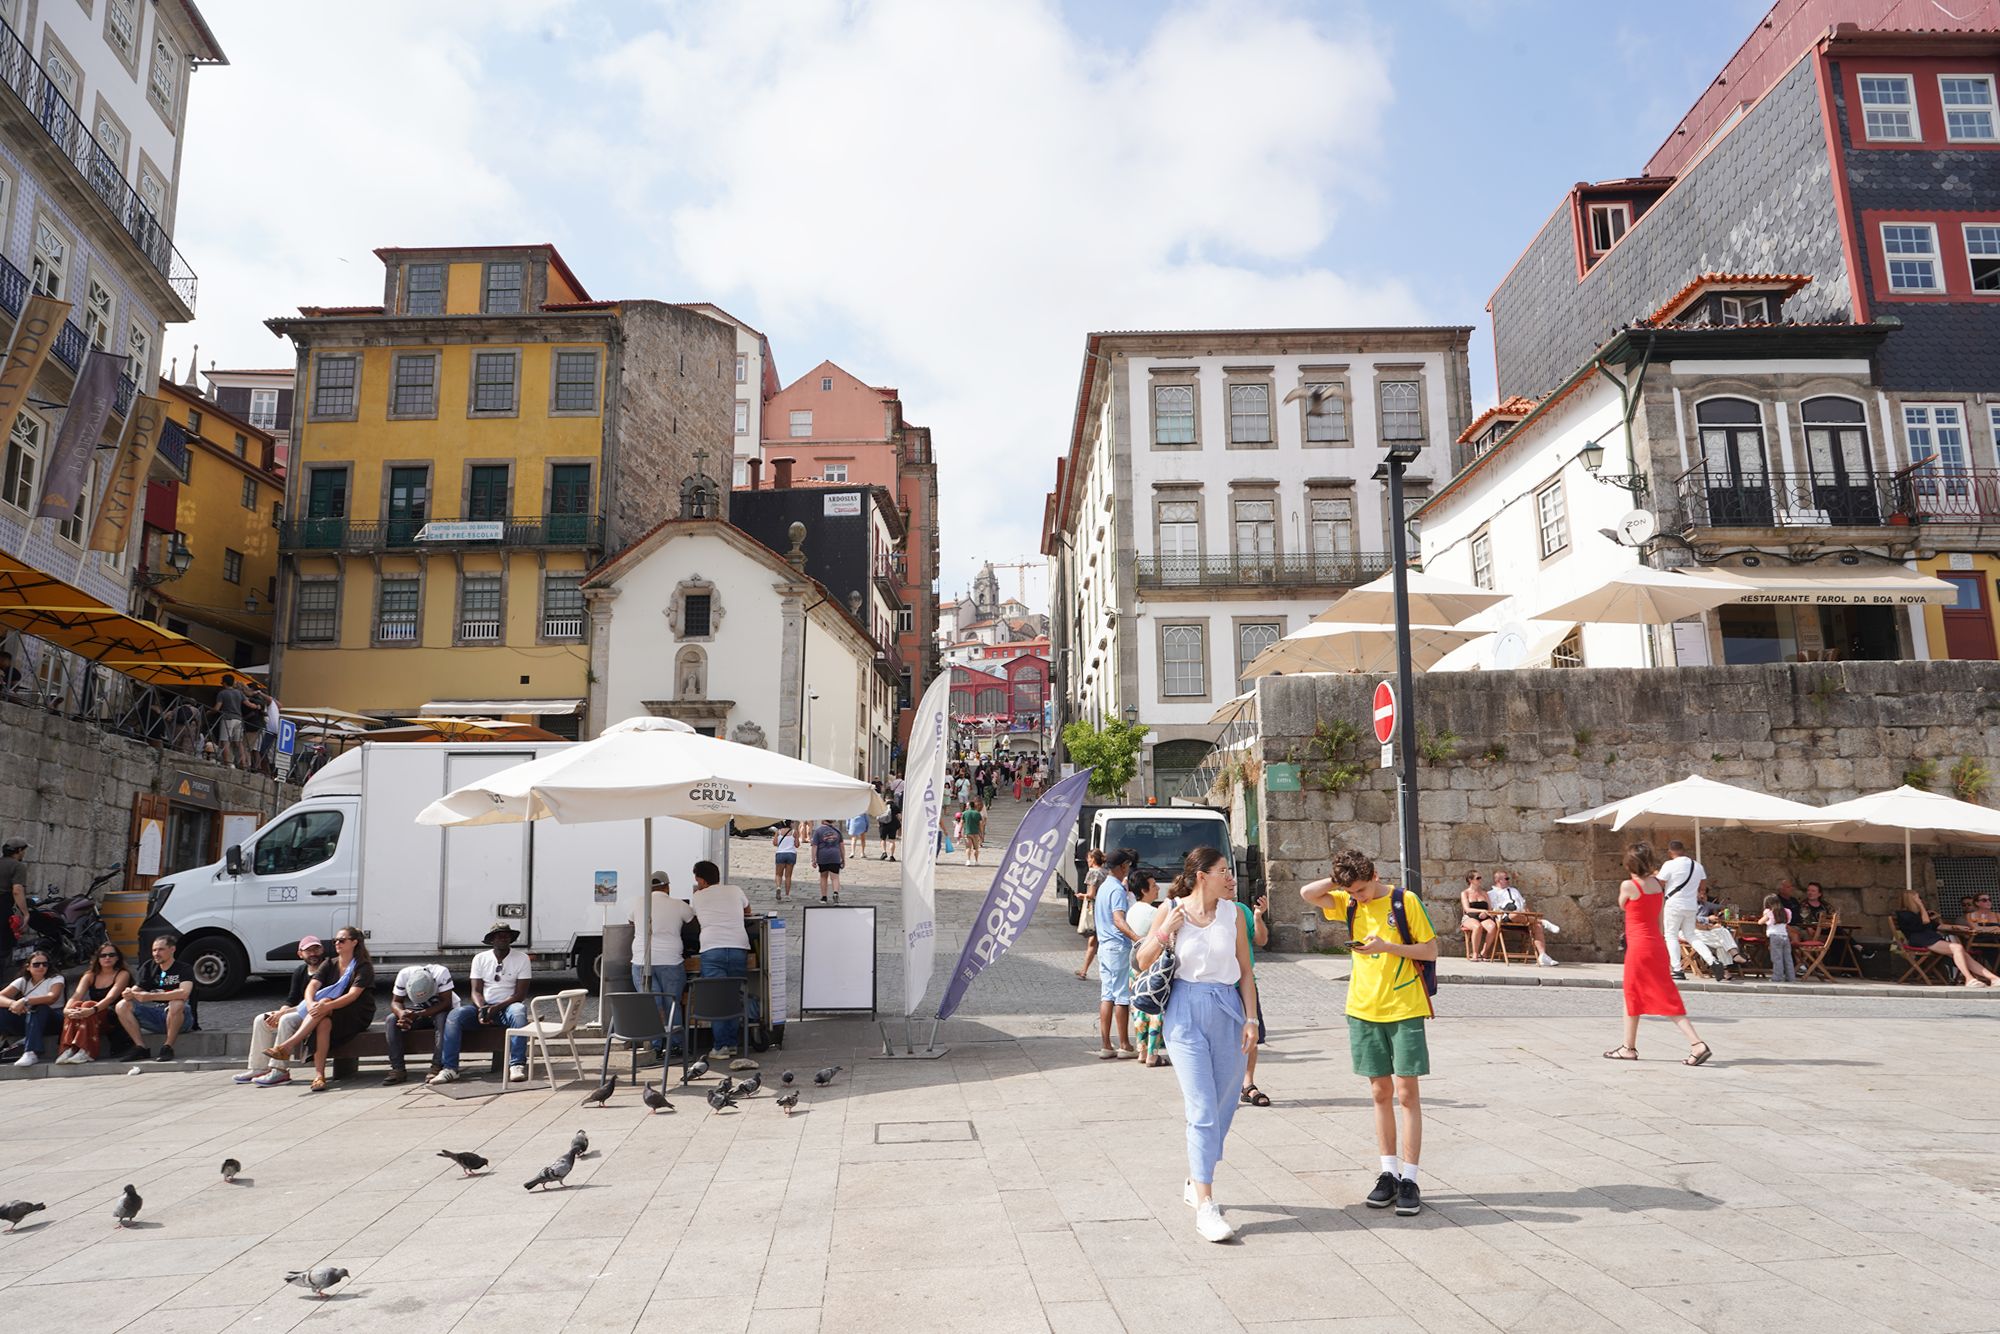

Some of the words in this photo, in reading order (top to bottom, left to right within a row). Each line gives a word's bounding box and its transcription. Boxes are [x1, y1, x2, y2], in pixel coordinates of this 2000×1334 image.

[1626, 518, 1647, 528] ZON
[1740, 595, 1811, 603] RESTAURANTE
[1817, 595, 1847, 603] FAROL
[1853, 595, 1866, 603] DA
[1873, 595, 1893, 603] BOA
[1900, 595, 1927, 603] NOVA
[696, 782, 729, 790] PORTO
[689, 789, 737, 802] CRUZ
[974, 840, 1034, 961] DOURO
